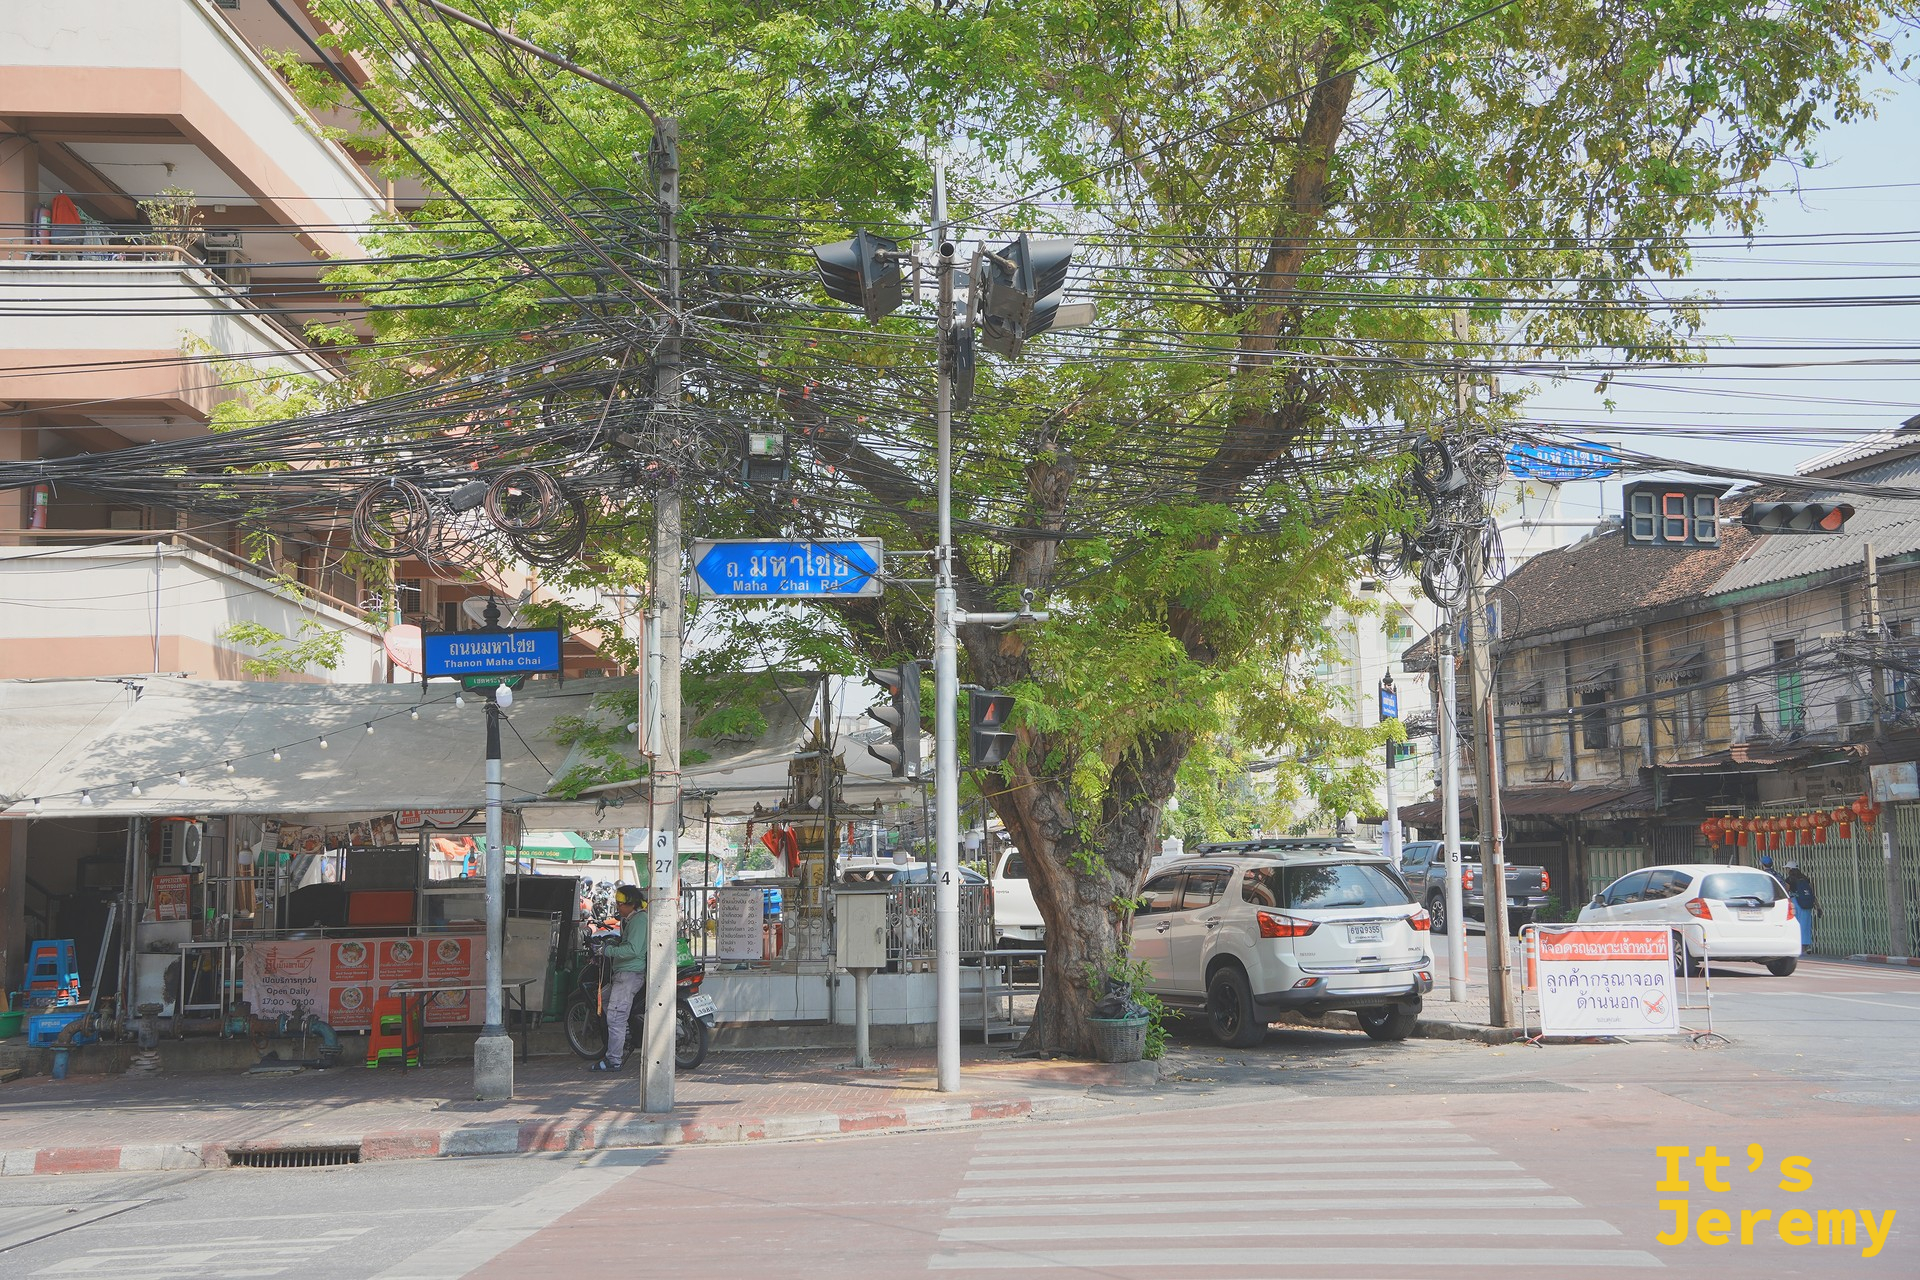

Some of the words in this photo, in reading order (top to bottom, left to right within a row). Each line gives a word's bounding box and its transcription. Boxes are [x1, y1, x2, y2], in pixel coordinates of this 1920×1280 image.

[726, 562, 744, 577] ถ.
[750, 543, 849, 577] มหาไชย
[733, 580, 767, 591] Maha
[780, 579, 809, 591] Chai
[821, 579, 842, 591] Rd.
[449, 633, 535, 656] ถนนมหาไชย
[444, 659, 482, 668] Thanon
[486, 658, 514, 667] Maha
[517, 656, 541, 665] Chai
[1451, 852, 1459, 863] 5
[655, 860, 672, 873] 27
[941, 871, 951, 886] 4
[262, 976, 317, 985] เปิดบริการทุกวัน
[1546, 968, 1665, 994] ลูกค้ากรุณาจอด
[266, 987, 288, 996] Open
[289, 987, 311, 996] Daily
[262, 998, 284, 1006] 17:00
[1576, 990, 1639, 1009] ด้านนอก
